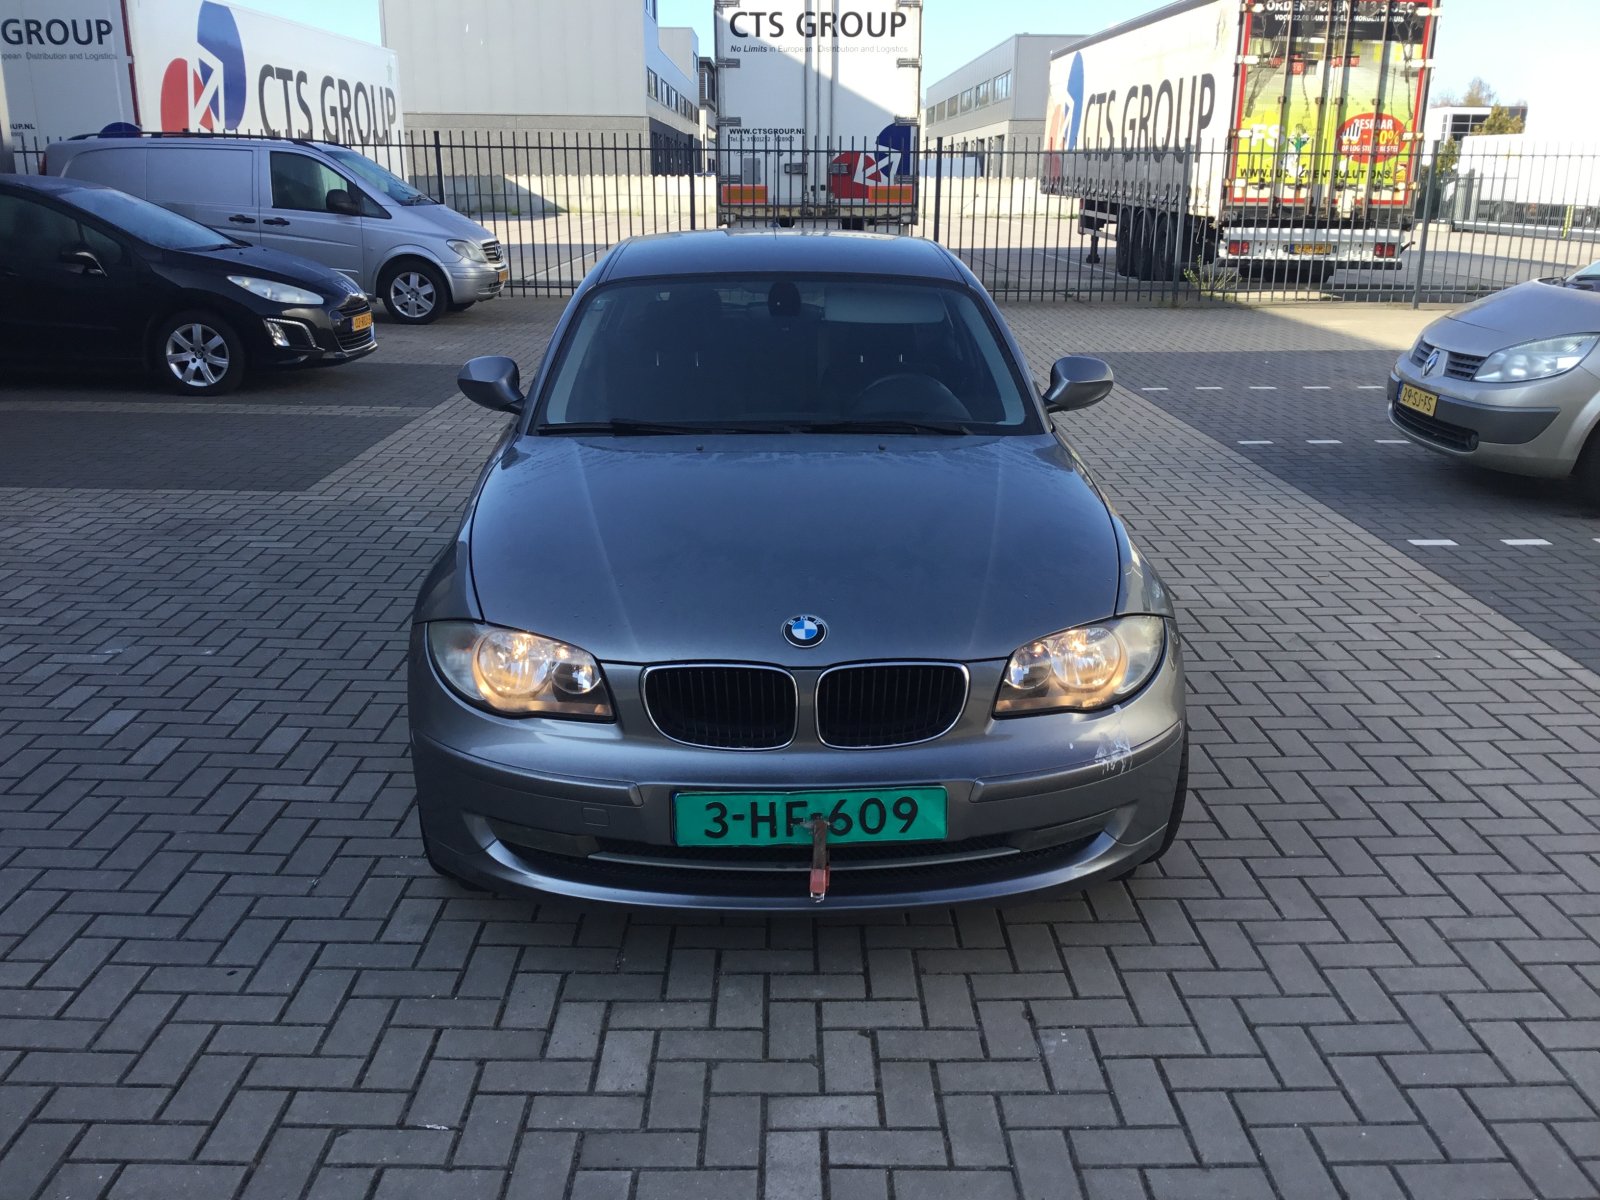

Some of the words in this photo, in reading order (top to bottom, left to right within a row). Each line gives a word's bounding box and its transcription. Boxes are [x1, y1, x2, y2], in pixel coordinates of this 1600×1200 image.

[1, 18, 113, 46] GROUP
[730, 11, 784, 38] CTS
[796, 11, 907, 38] GROUP
[26, 52, 67, 60] Distribution
[69, 52, 83, 60] and
[85, 52, 118, 61] Logistics
[730, 45, 742, 53] No
[743, 45, 768, 53] Limits
[769, 45, 776, 53] in
[777, 45, 813, 54] European
[818, 45, 859, 53] Distribution
[876, 45, 908, 55] Logistics
[258, 64, 314, 140] CTS
[320, 75, 396, 145] GROUP
[1083, 89, 1117, 162] CTS
[1121, 73, 1216, 164] GROUP
